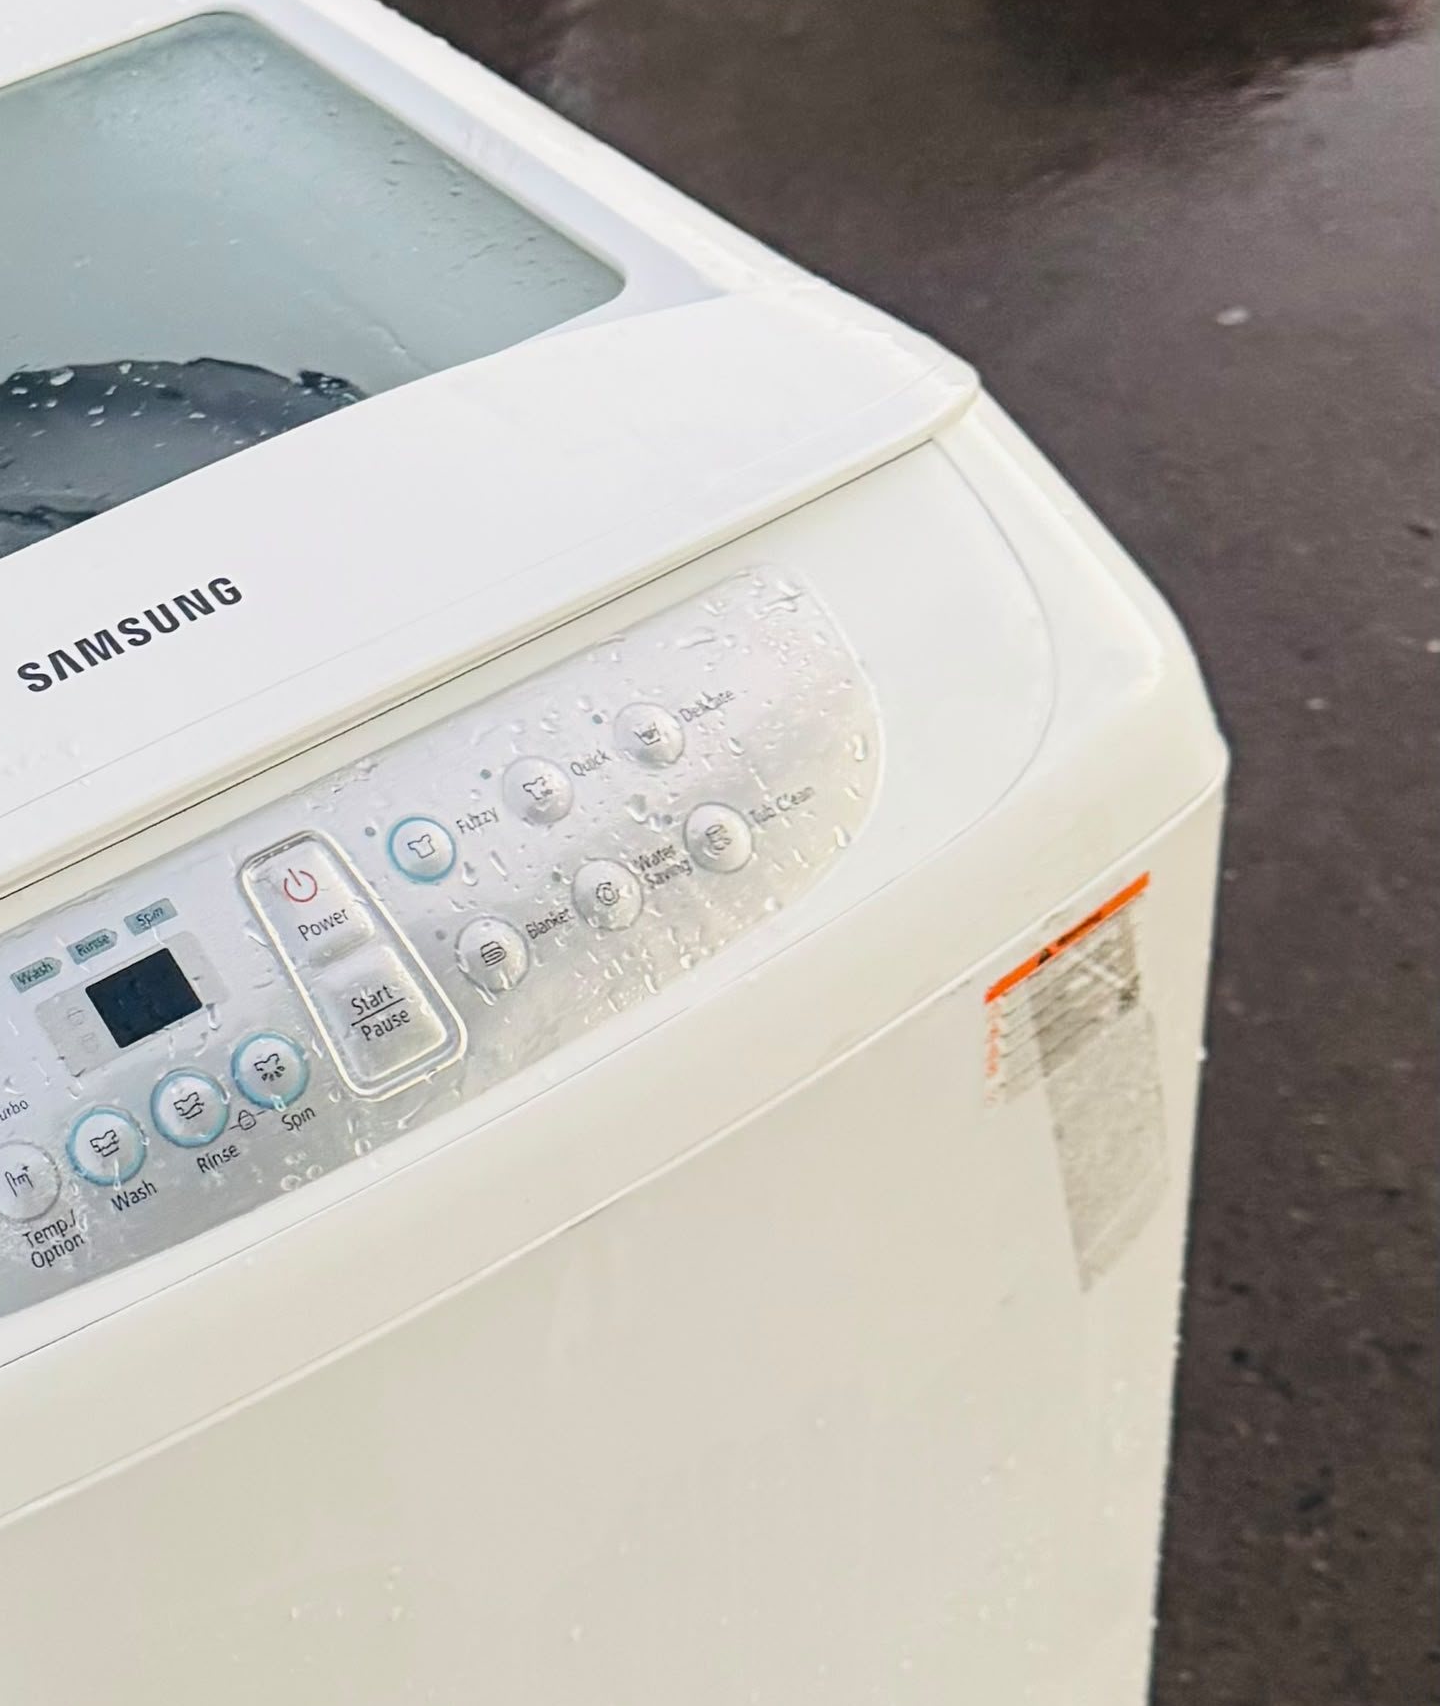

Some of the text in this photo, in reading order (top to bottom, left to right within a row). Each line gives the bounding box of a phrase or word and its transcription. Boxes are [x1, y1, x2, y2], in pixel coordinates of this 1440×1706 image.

[17, 577, 243, 692] SAMSUNG
[570, 749, 612, 778] Quick
[456, 805, 500, 835] Fuzzy
[297, 908, 350, 942] Power
[74, 933, 111, 958] Rinse
[16, 961, 54, 986] Wash
[350, 984, 394, 1016] Start
[360, 1009, 411, 1042] Pause
[280, 1106, 317, 1135] Spin
[196, 1143, 241, 1175] Rinse
[111, 1180, 158, 1213] Wash
[30, 1232, 86, 1270] Option
